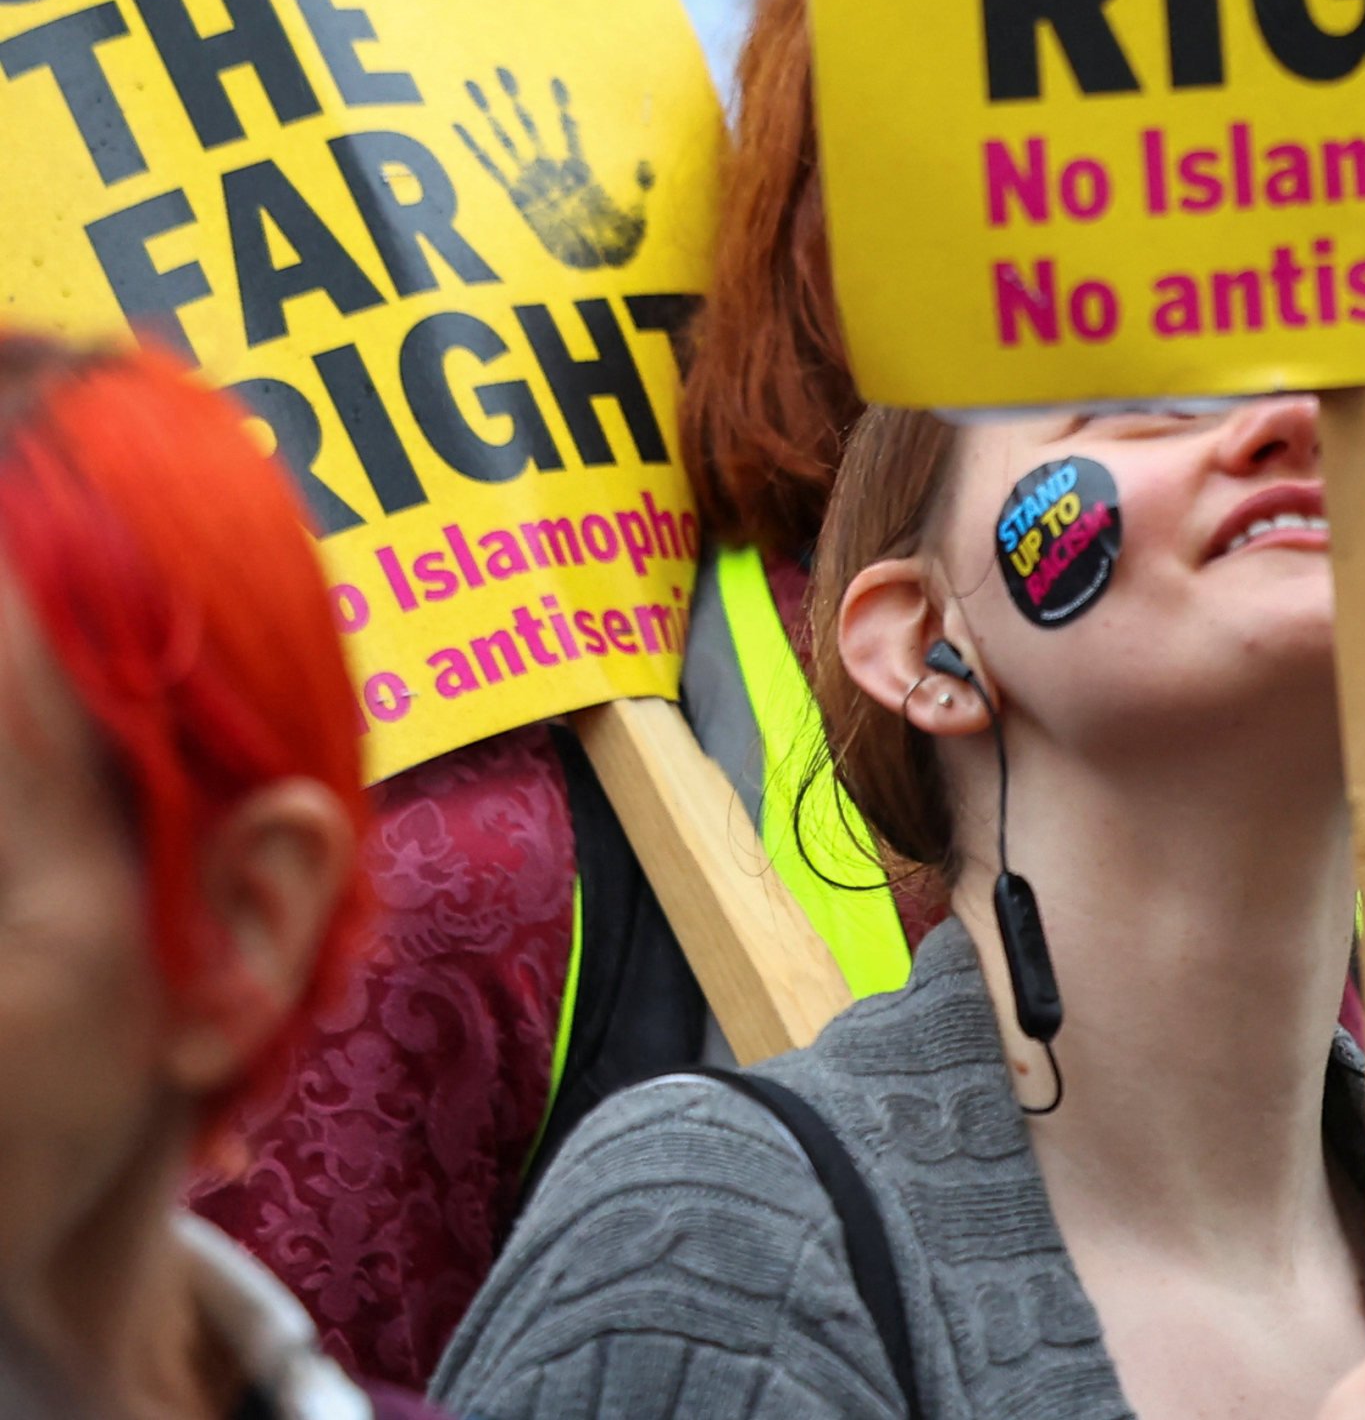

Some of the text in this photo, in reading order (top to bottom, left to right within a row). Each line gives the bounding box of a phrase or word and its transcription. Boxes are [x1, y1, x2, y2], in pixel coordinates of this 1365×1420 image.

[981, 135, 1112, 228] No
[84, 131, 502, 370] FAR
[992, 258, 1121, 348] No
[1000, 464, 1078, 553] STAND
[1009, 527, 1043, 578] UP
[1040, 491, 1082, 539] TO
